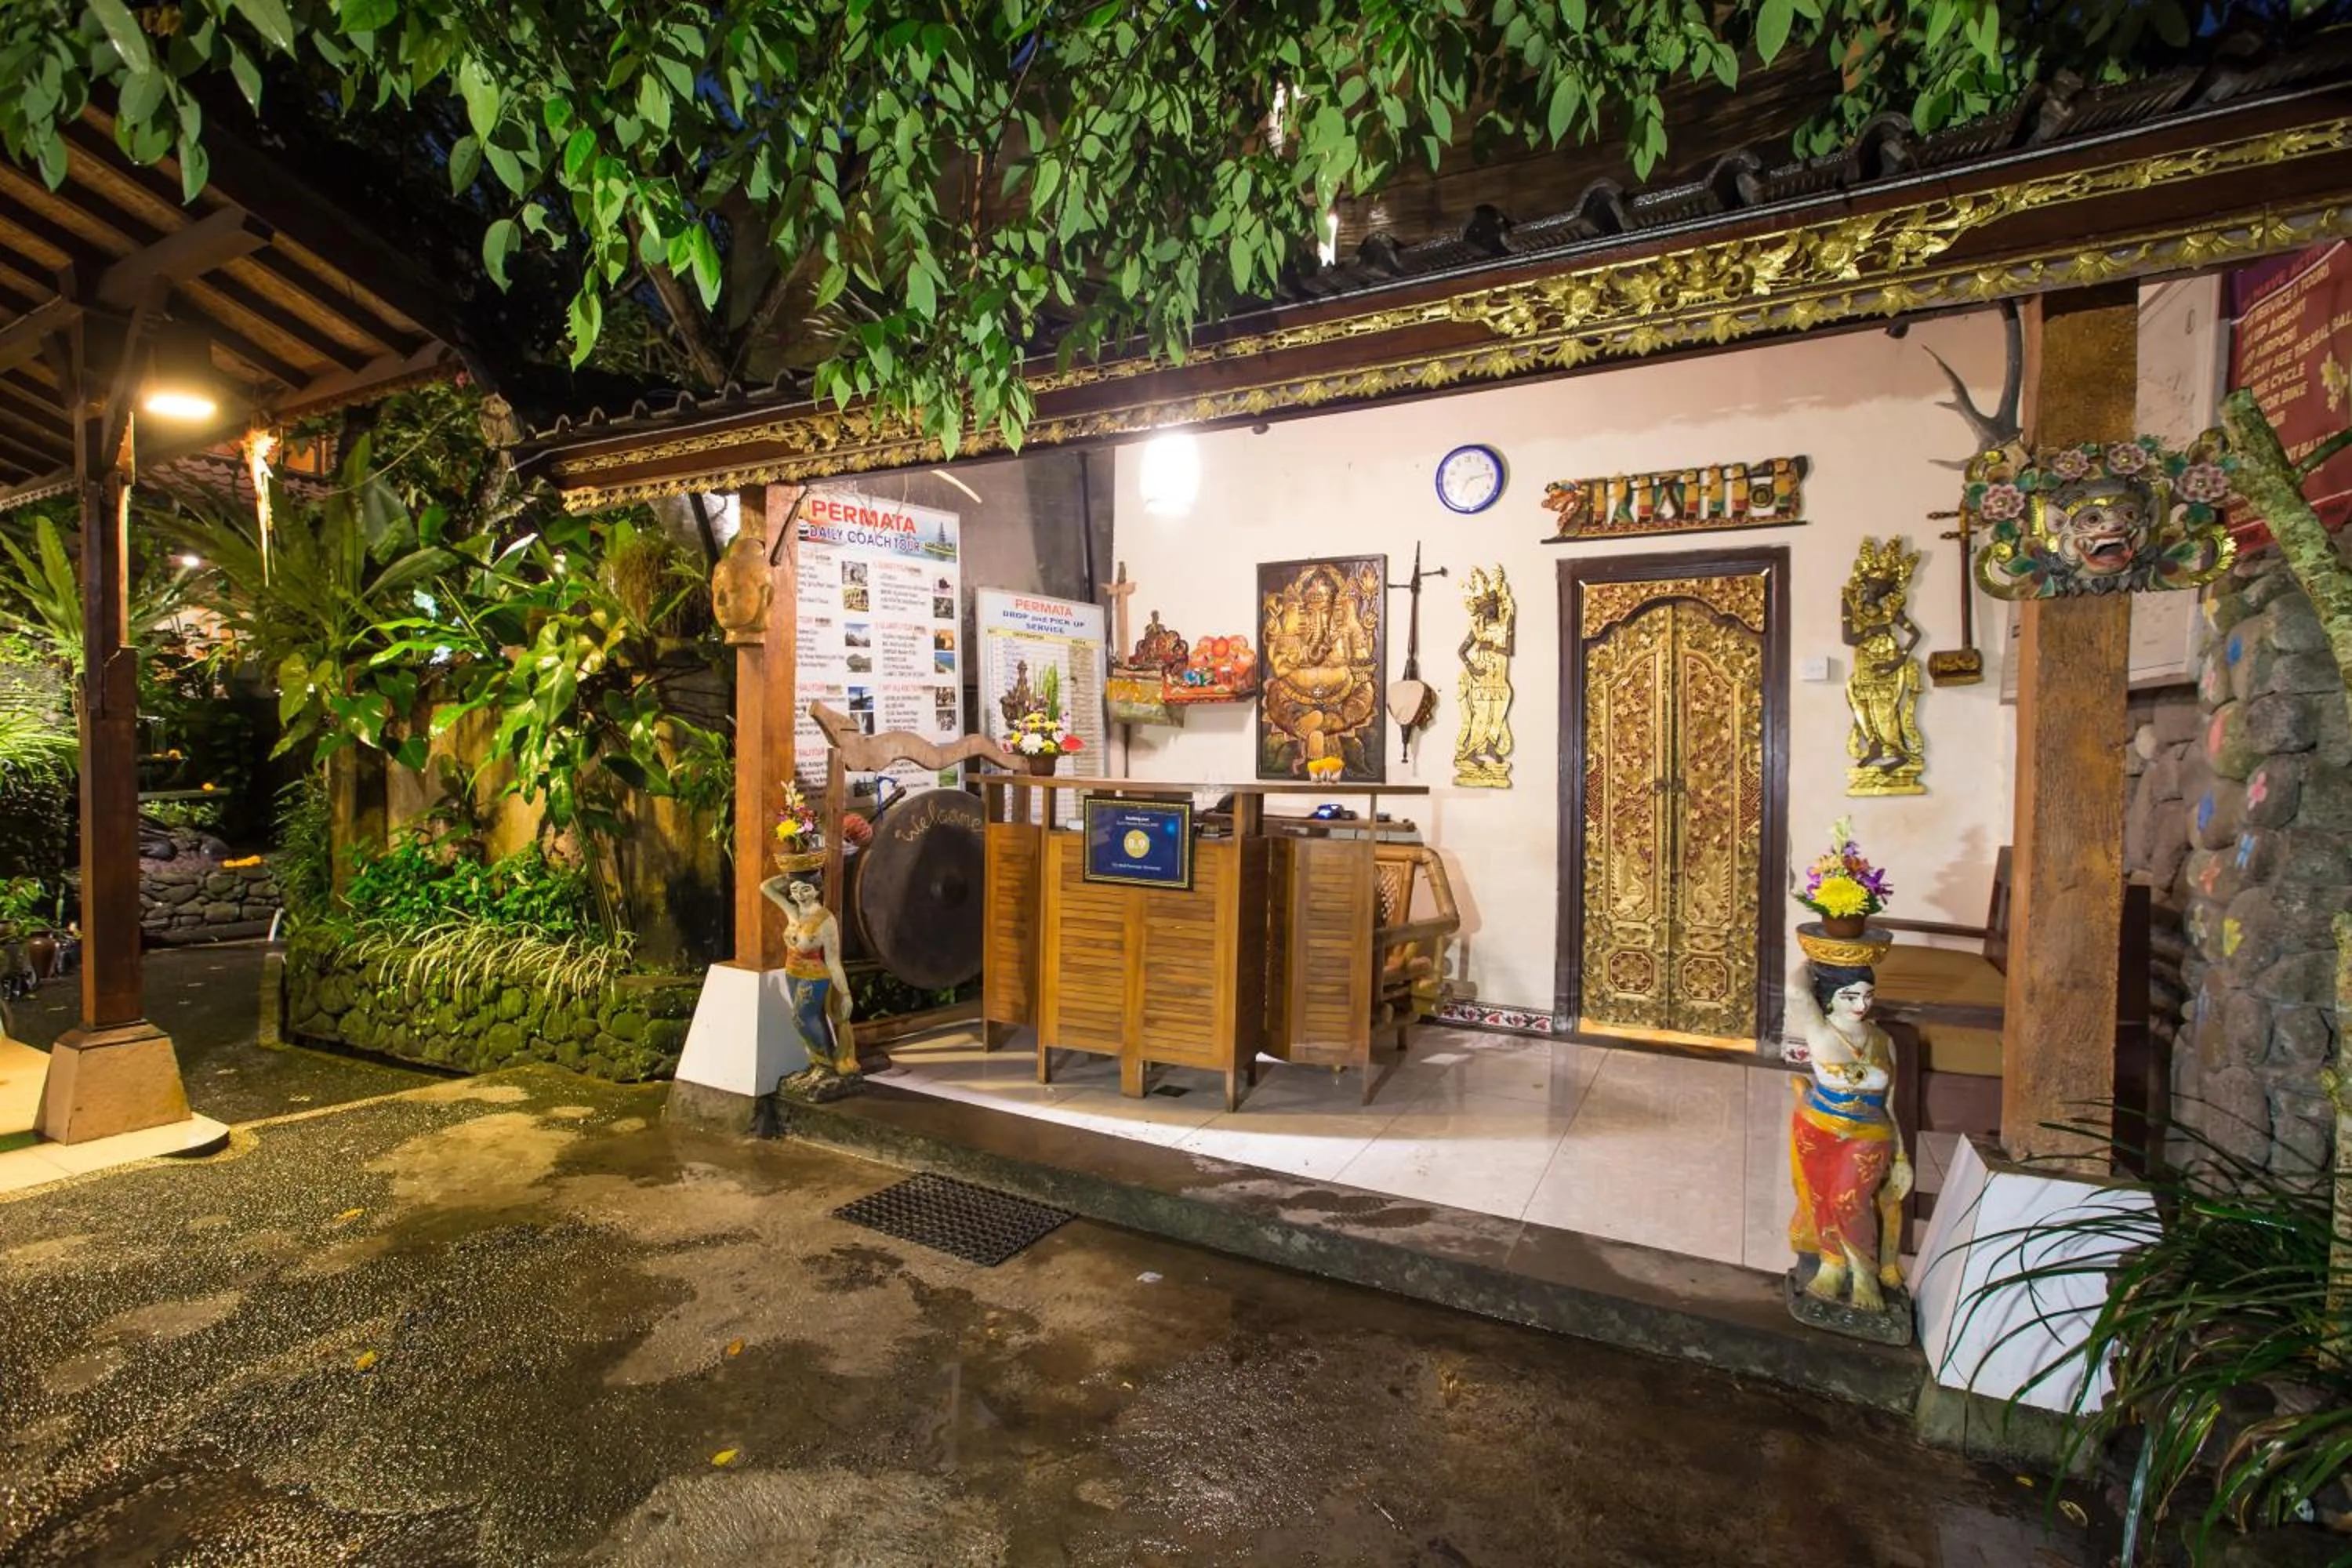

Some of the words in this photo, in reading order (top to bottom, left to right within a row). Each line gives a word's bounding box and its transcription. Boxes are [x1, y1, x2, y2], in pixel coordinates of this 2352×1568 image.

[2270, 361, 2306, 389] CYCLE
[811, 499, 916, 533] PERMATA
[810, 525, 843, 541] DAILY
[848, 531, 891, 547] COACH
[894, 538, 920, 552] TOUR
[1014, 598, 1073, 617] PERMATA
[1025, 622, 1065, 634] SERVICE
[1050, 617, 1070, 626] PICK
